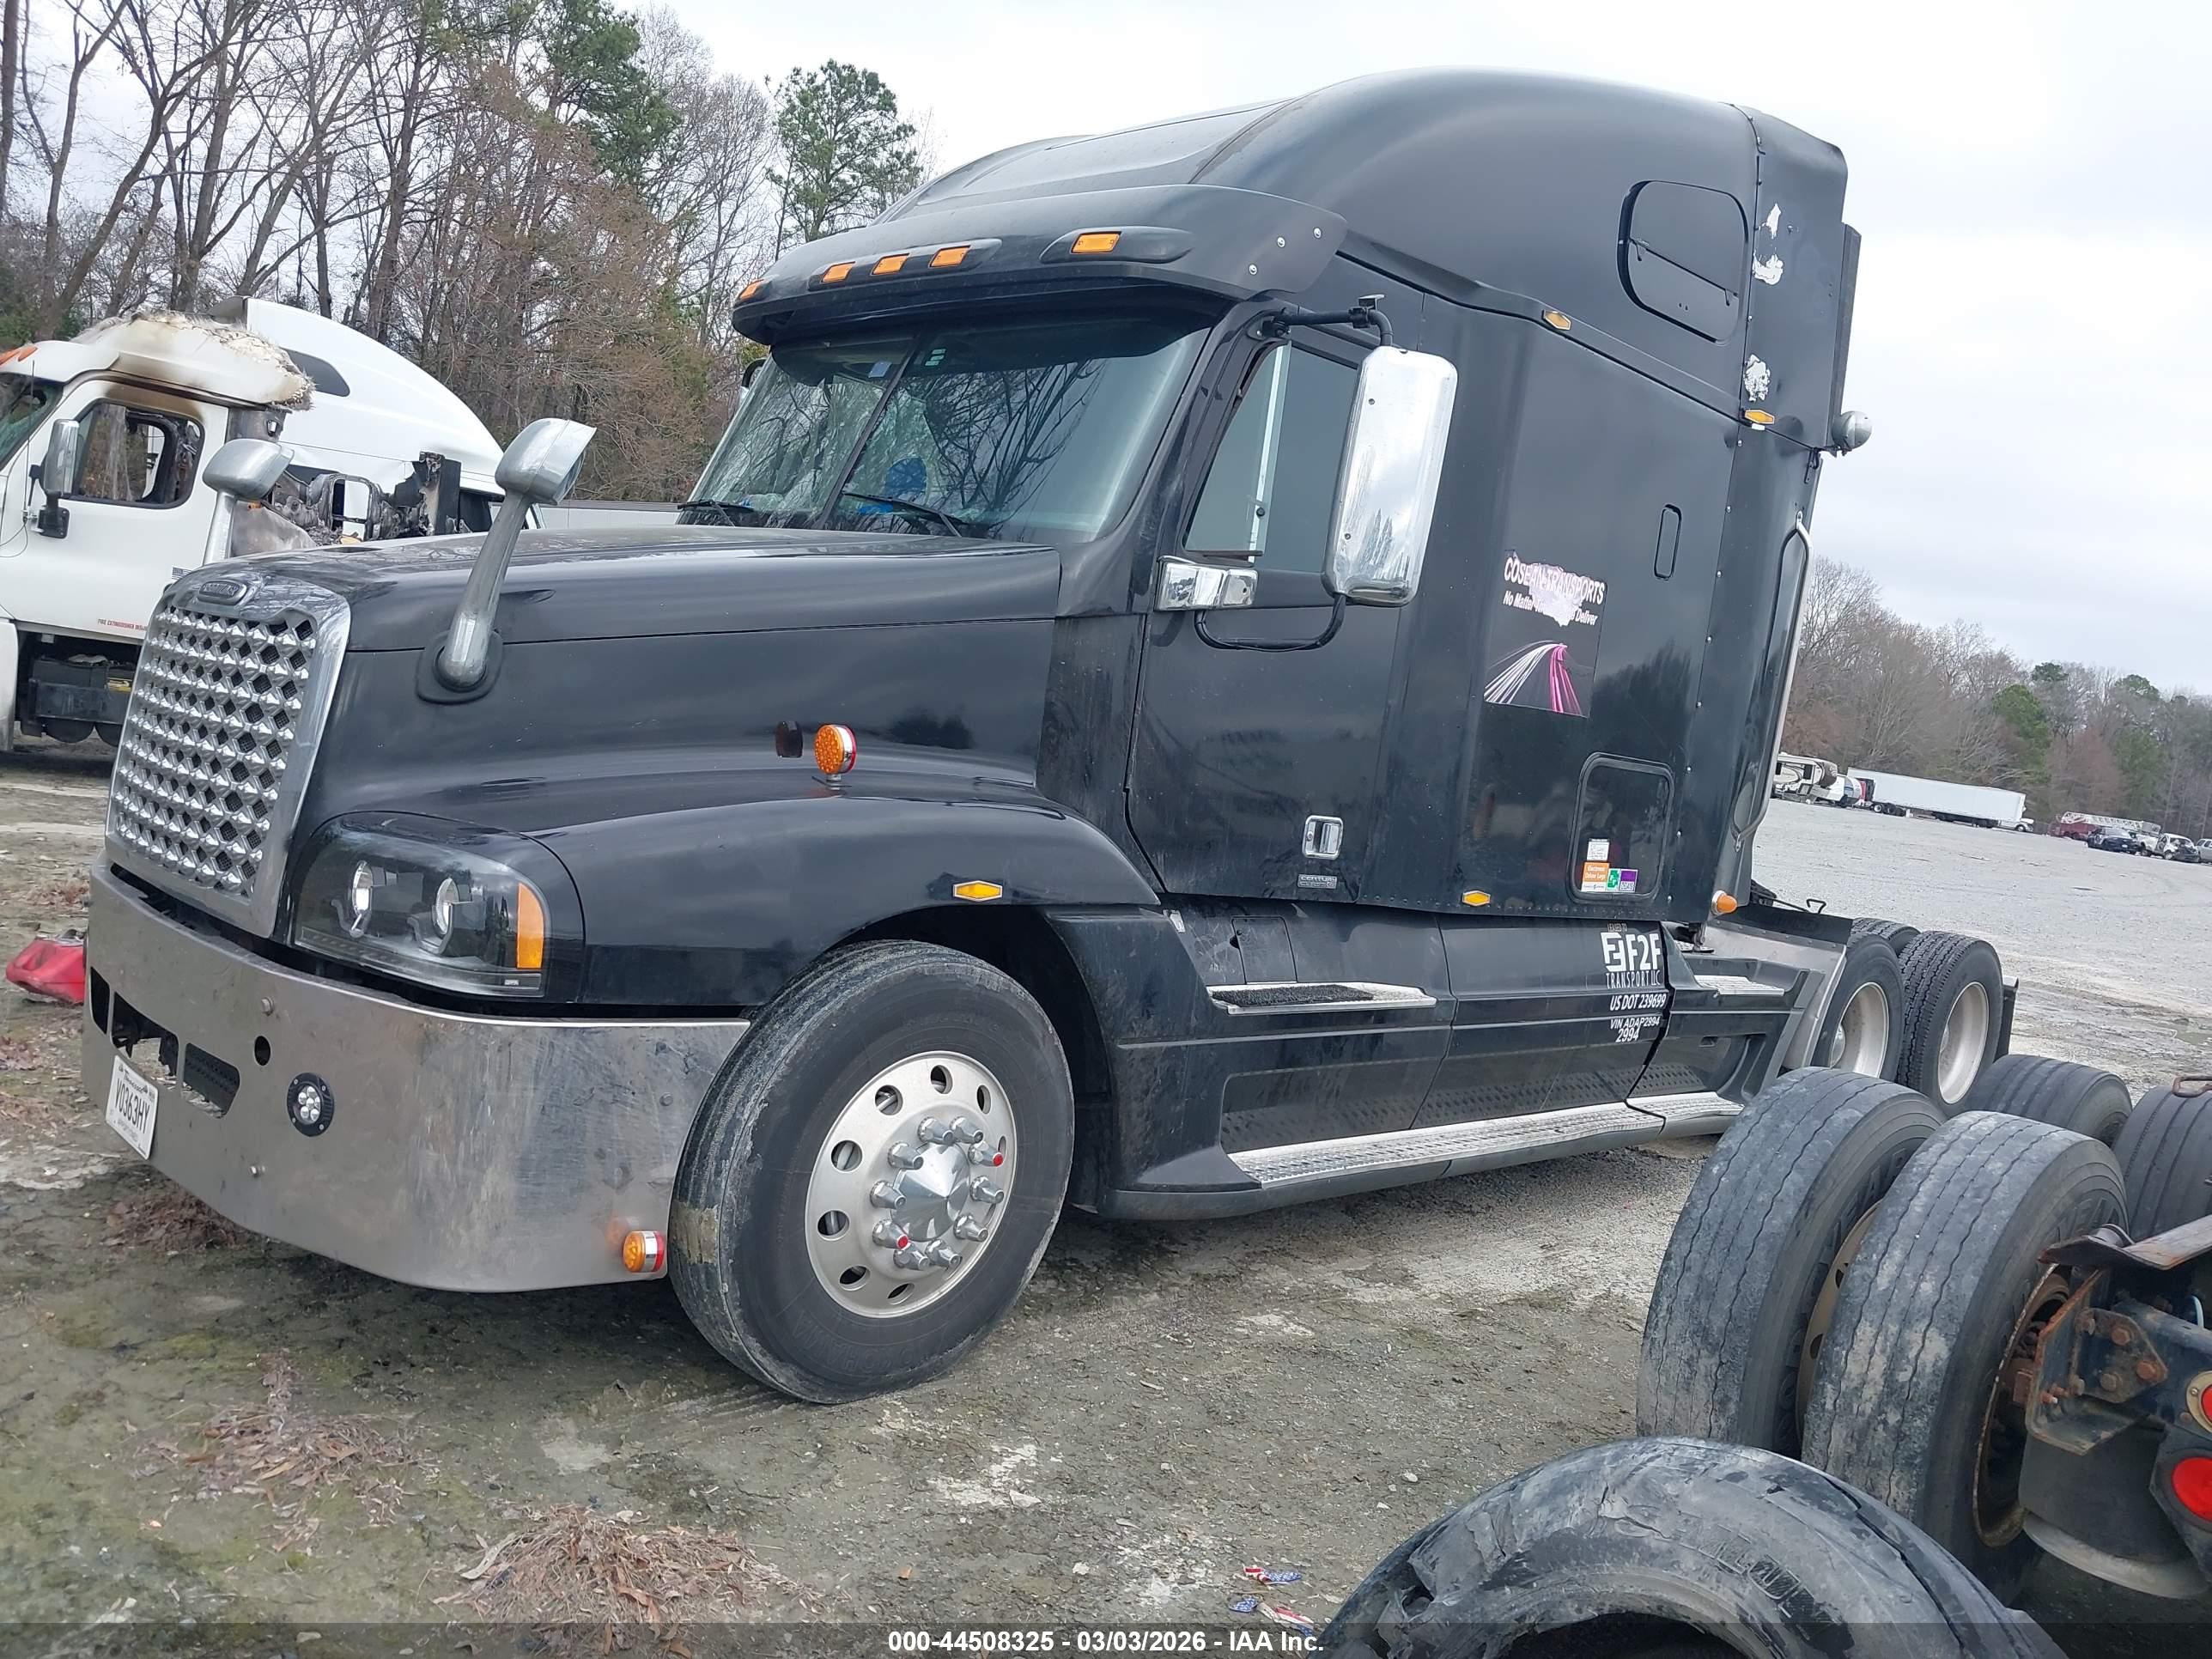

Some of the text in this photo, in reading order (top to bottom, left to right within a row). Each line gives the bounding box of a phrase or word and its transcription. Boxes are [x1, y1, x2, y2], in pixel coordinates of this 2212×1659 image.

[1625, 933, 1662, 971] F2F
[1606, 969, 1661, 990] TRANSPORT LLC
[1609, 993, 1667, 1012] US DOT 239699
[1609, 1018, 1625, 1030] VIN
[1614, 1026, 1640, 1043] 2994
